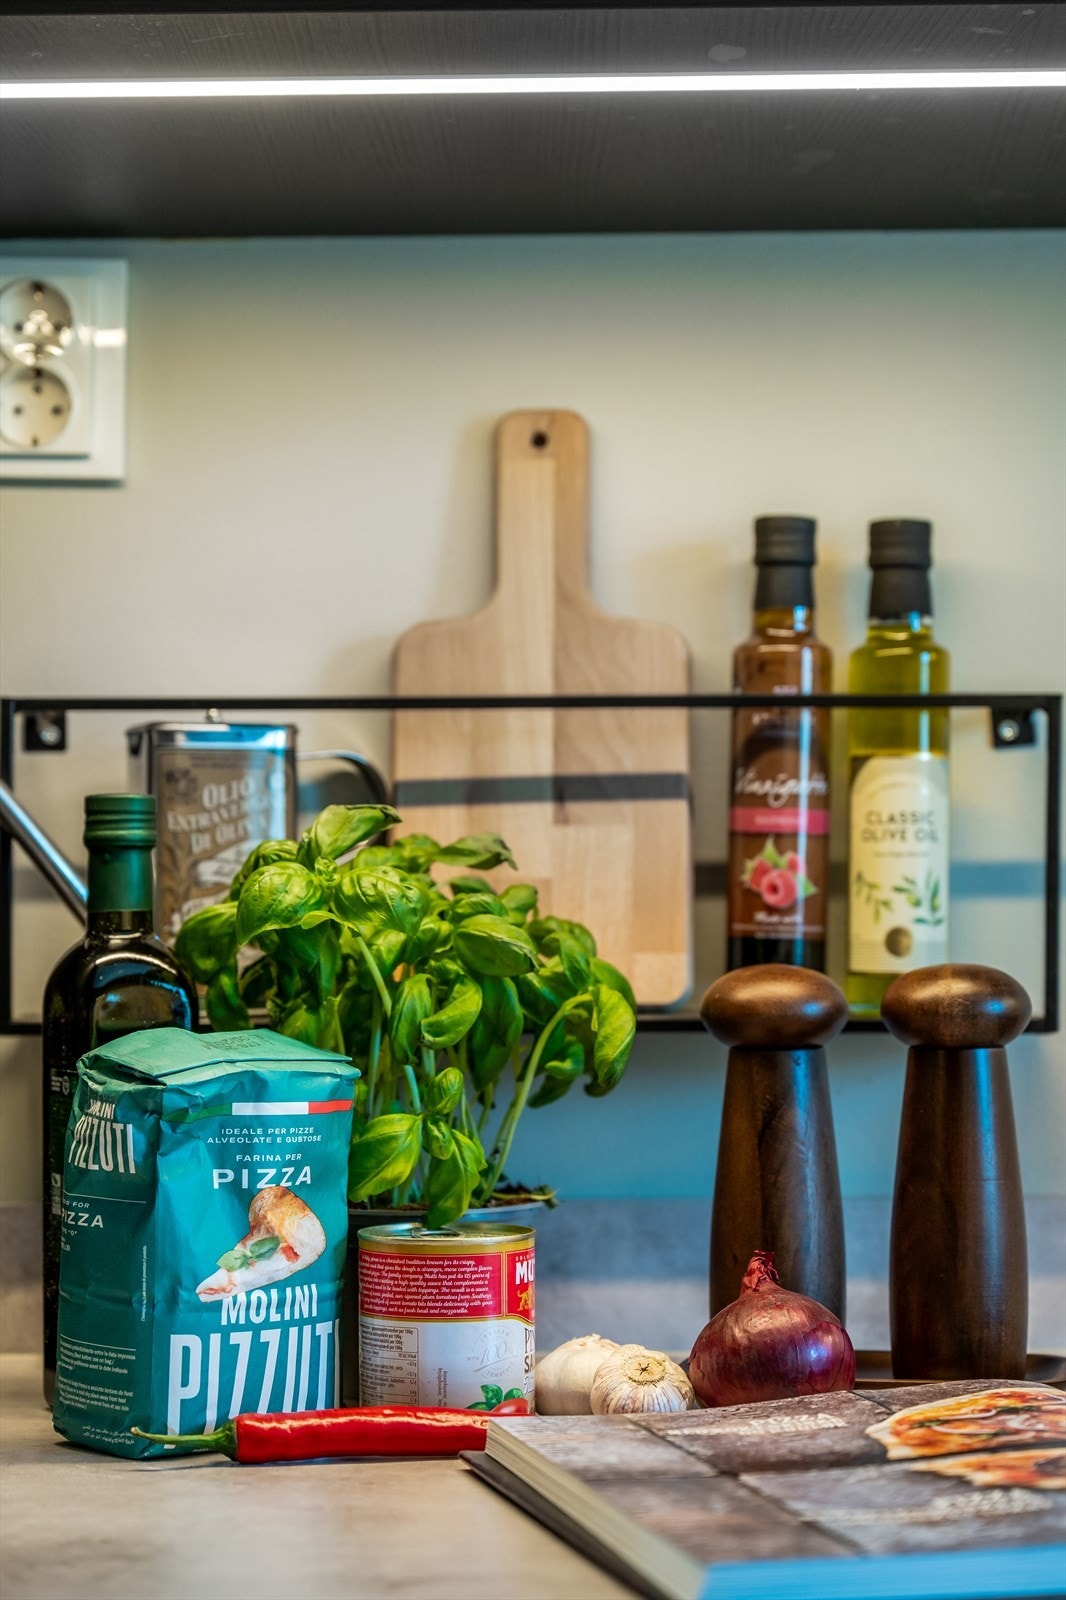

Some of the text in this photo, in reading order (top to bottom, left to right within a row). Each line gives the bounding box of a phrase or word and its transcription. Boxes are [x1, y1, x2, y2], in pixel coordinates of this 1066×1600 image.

[865, 810, 936, 825] CLASSIC
[861, 828, 938, 844] OLIVE OIL
[207, 1136, 273, 1144] ALVEOLATE
[286, 1135, 322, 1143] GUSTOSE
[236, 1153, 302, 1162] FARINA PER
[212, 1165, 312, 1190] PIZZA
[73, 1201, 90, 1209] FOR
[458, 1265, 477, 1273] complex
[516, 1258, 535, 1285] MU
[221, 1283, 318, 1326] MOLINI
